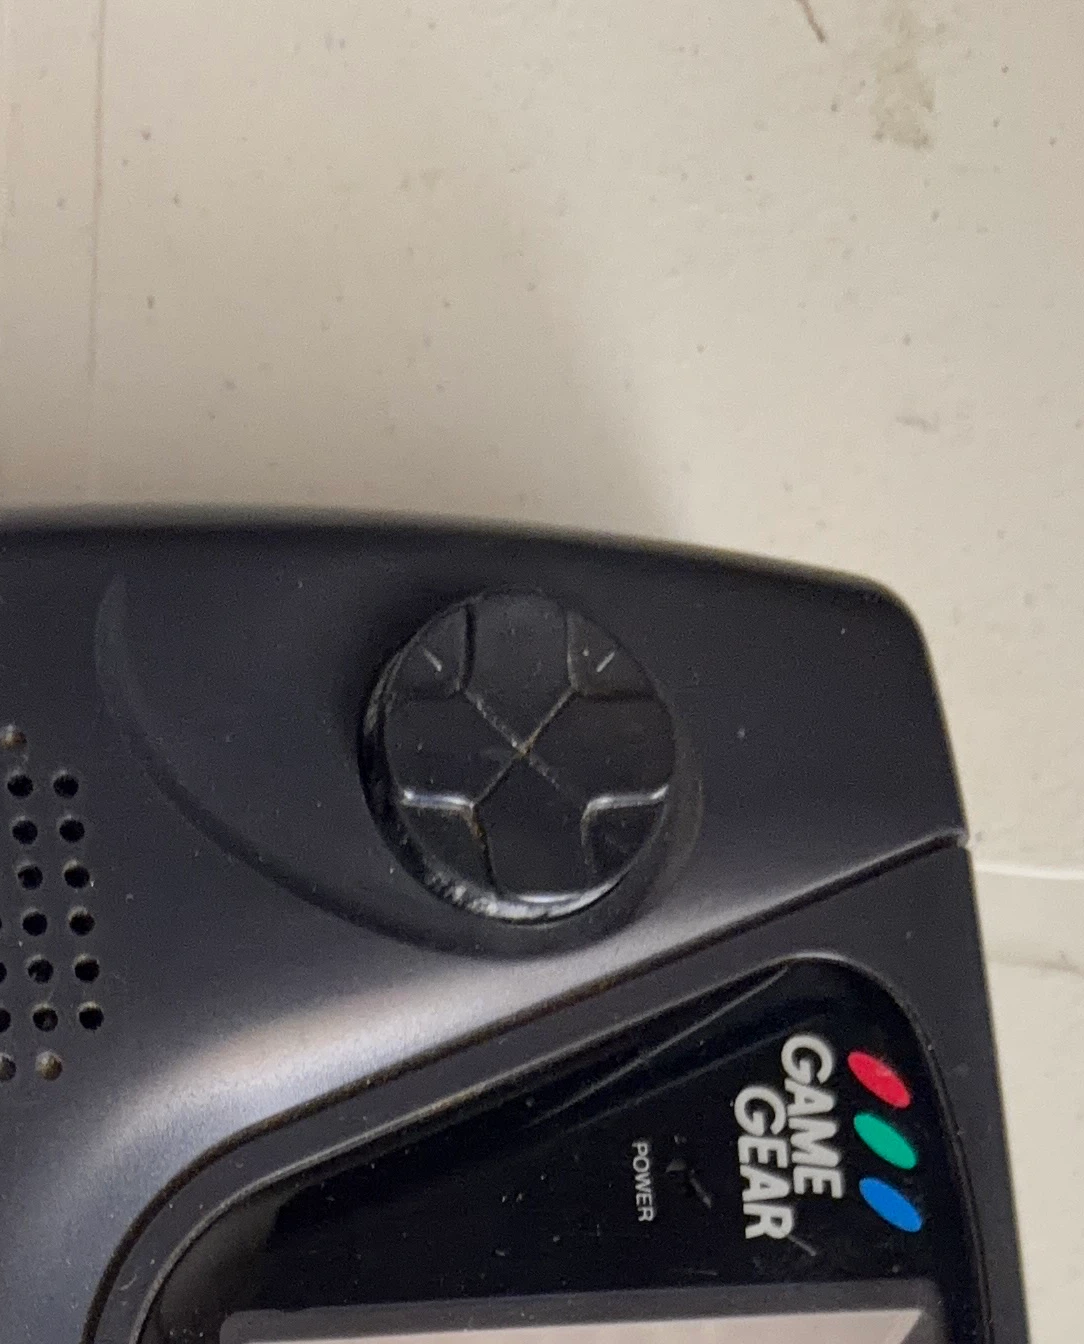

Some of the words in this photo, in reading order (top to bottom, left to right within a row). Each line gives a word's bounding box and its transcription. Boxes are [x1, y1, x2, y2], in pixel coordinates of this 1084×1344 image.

[631, 1142, 655, 1222] POWER
[734, 1085, 795, 1240] GEAR
[780, 1033, 844, 1199] GAME
